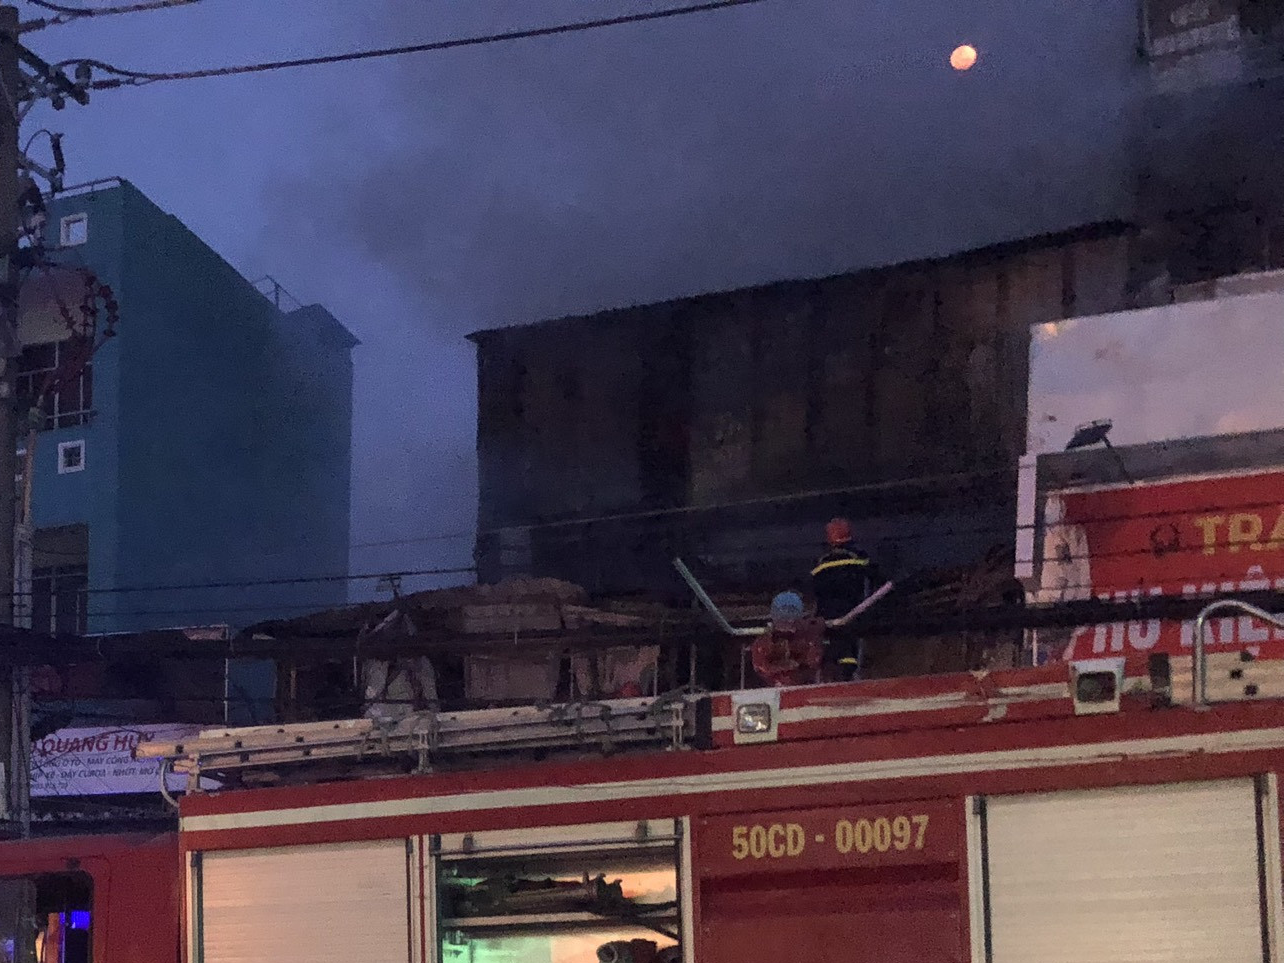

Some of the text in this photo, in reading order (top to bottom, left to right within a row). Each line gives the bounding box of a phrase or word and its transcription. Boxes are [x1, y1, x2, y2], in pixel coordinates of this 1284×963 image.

[41, 735, 111, 757] QUANG
[731, 822, 806, 860] 50CD
[834, 813, 930, 854] 00097
